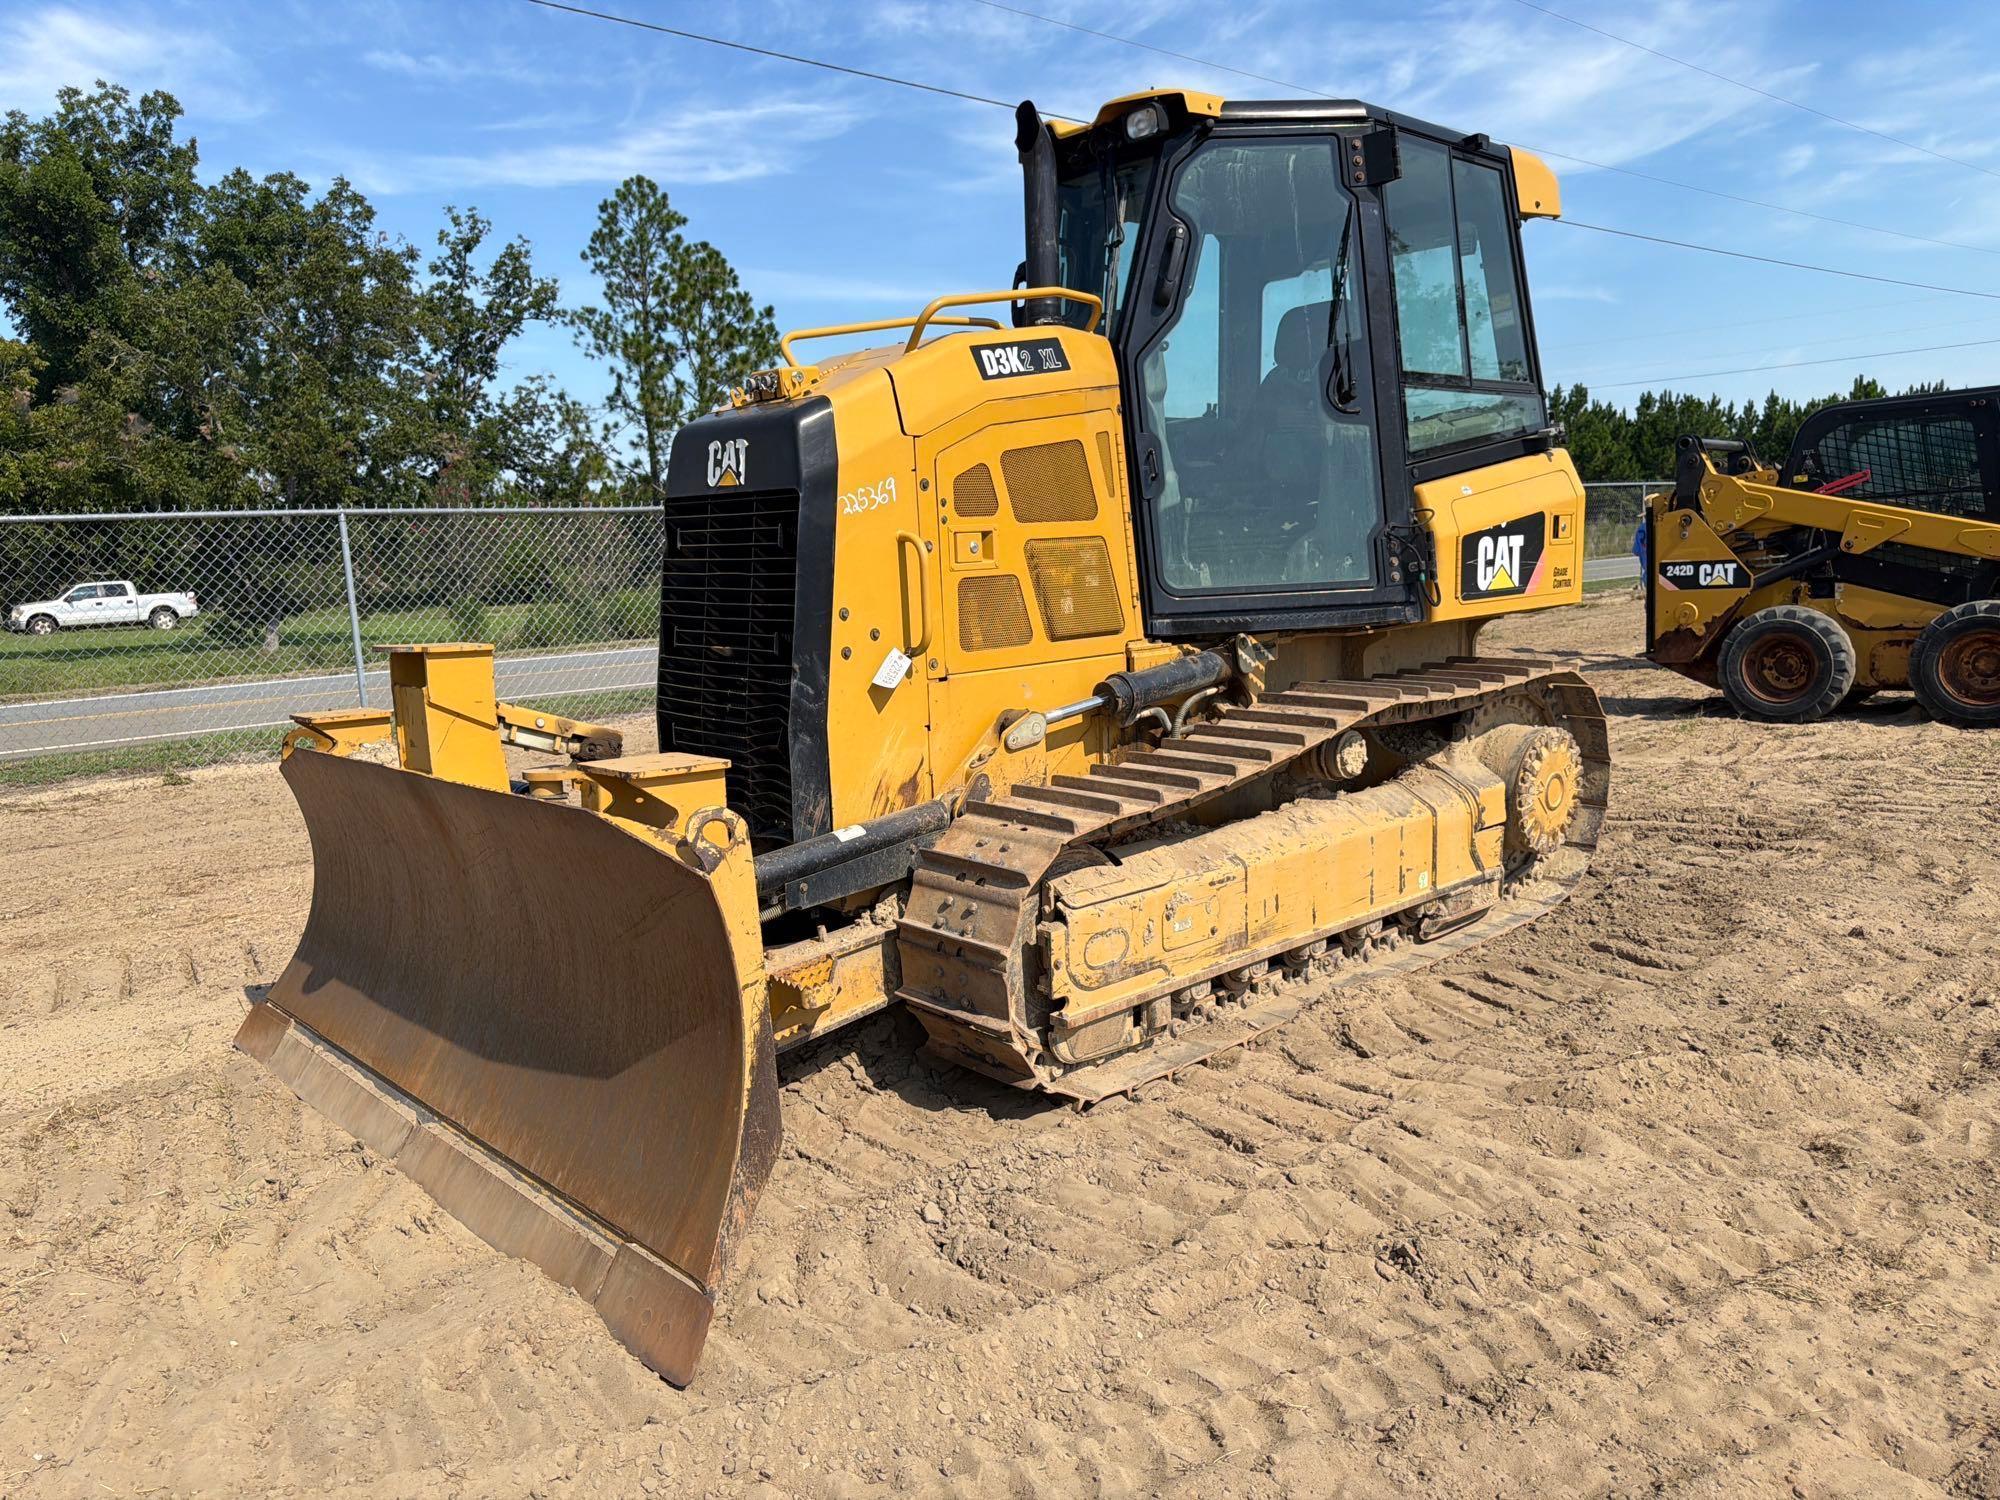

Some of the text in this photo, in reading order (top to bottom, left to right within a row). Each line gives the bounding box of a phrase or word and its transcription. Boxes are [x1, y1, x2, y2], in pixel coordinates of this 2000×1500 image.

[980, 346, 1062, 376] D3K2 XL
[707, 438, 749, 487] CAT
[838, 476, 896, 515] 225369
[1477, 534, 1525, 591] CAT
[1666, 563, 1737, 586] 242D CAT
